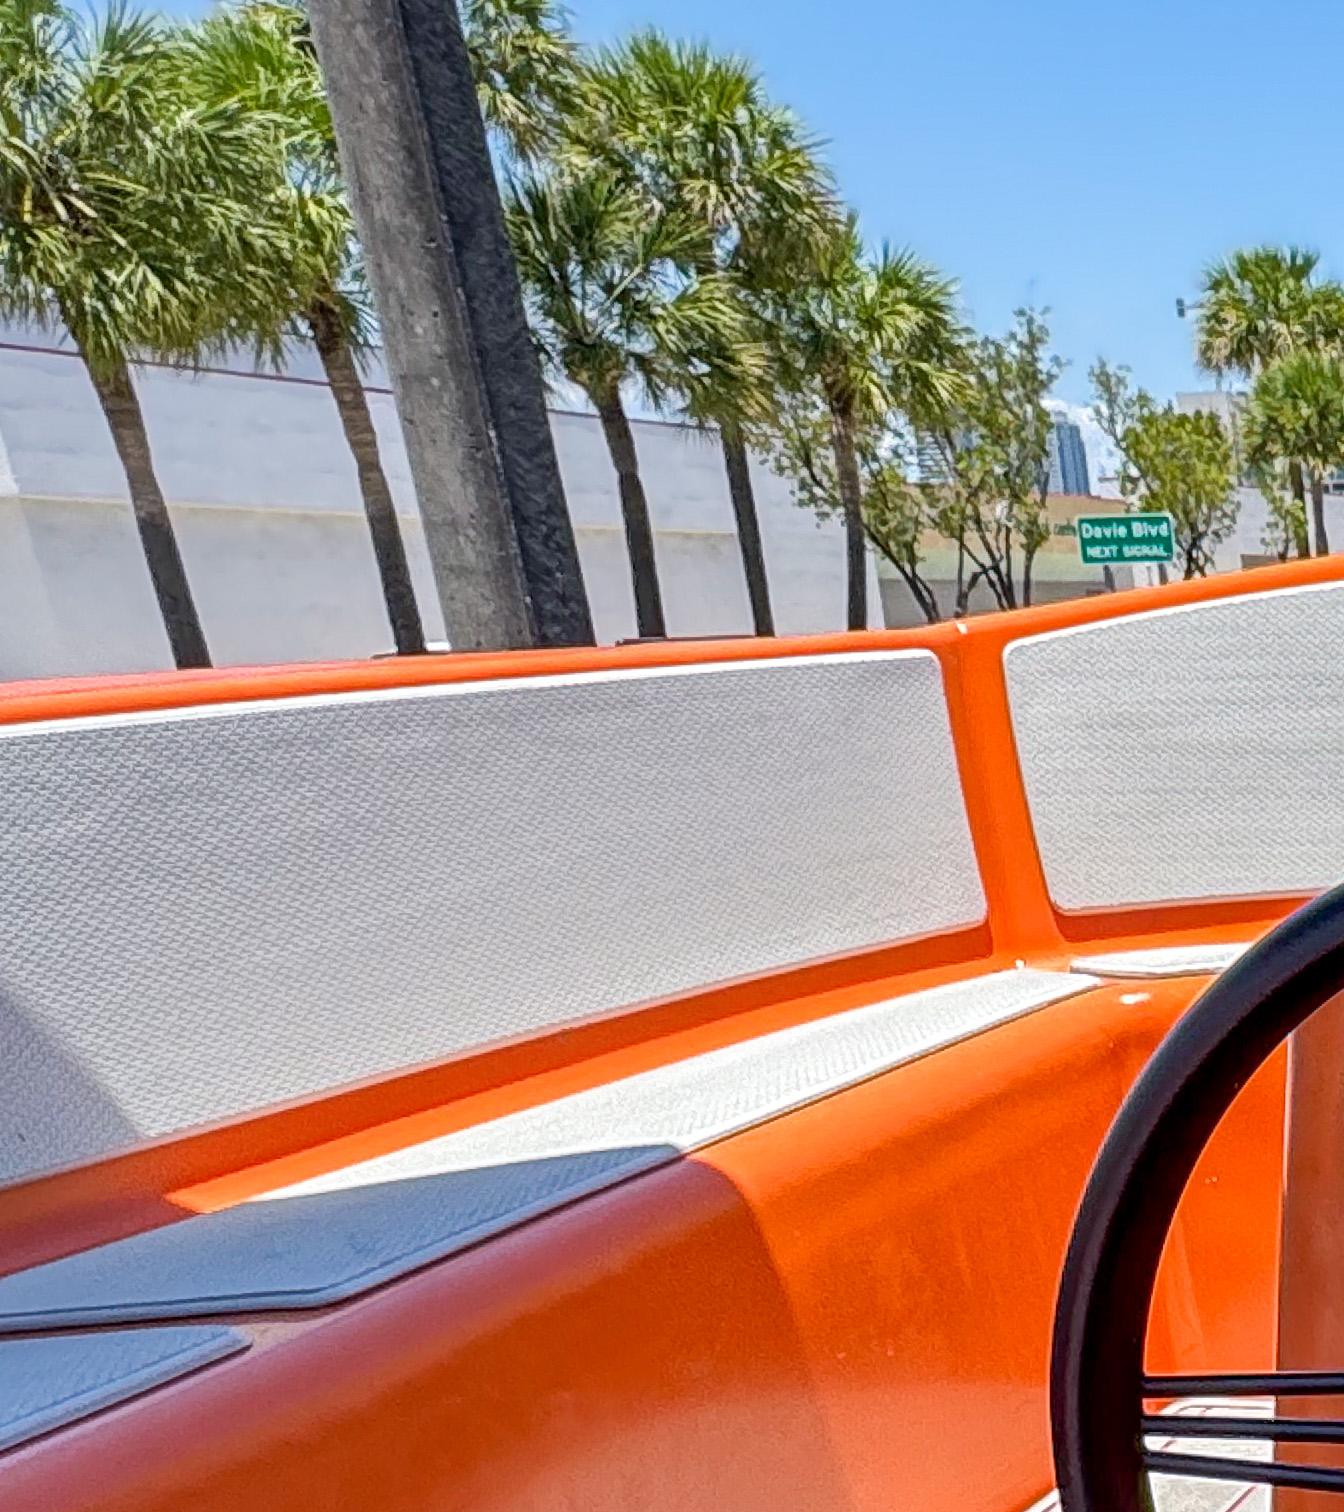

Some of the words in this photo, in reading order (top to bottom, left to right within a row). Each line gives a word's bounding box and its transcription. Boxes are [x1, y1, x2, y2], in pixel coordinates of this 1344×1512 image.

[1081, 522, 1127, 539] Davie
[1131, 520, 1168, 538] Blvd
[1086, 546, 1118, 558] NEXT
[1122, 544, 1169, 558] SIGNAL
